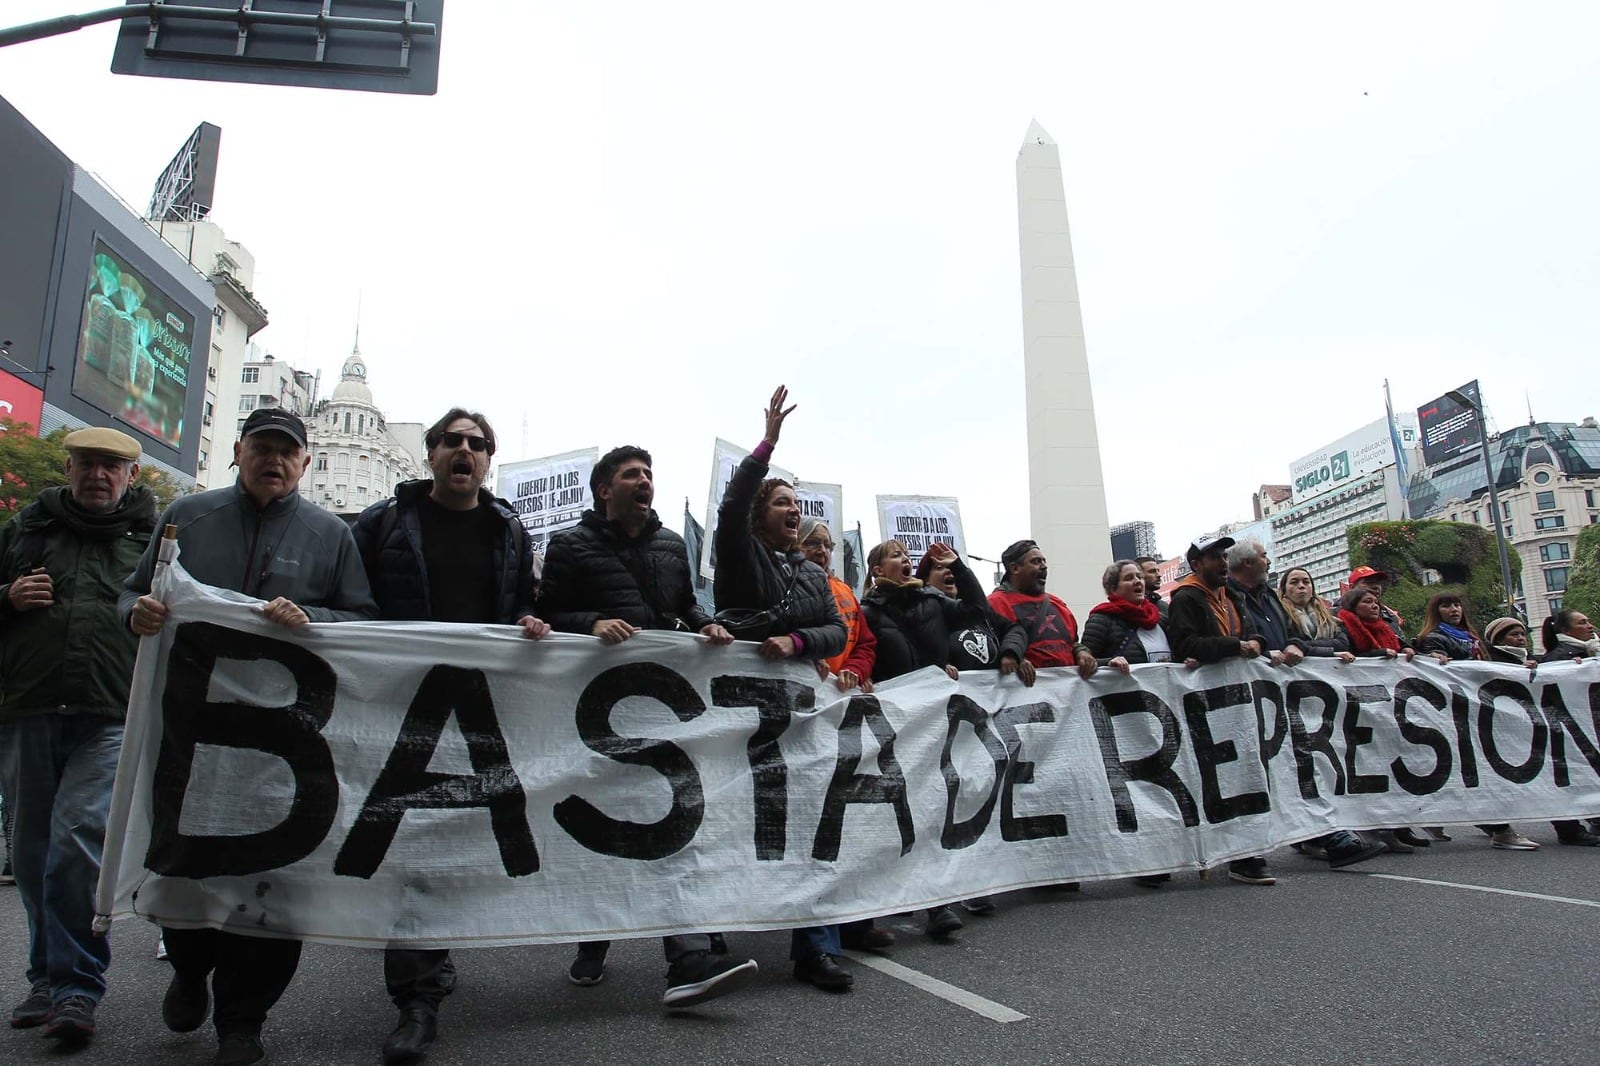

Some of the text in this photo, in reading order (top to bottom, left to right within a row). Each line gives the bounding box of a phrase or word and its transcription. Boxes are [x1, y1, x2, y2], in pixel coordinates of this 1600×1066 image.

[1295, 453, 1328, 474] UNIVERSIDAD
[1295, 458, 1346, 493] SIGLO 21
[517, 471, 579, 498] LIBERTAD A LOS
[512, 495, 543, 515] PRESOS
[557, 486, 584, 507] JUJUY
[810, 500, 824, 517] LOS
[935, 517, 948, 534] LOS
[144, 620, 1600, 878] BASTA DE REPRESION
